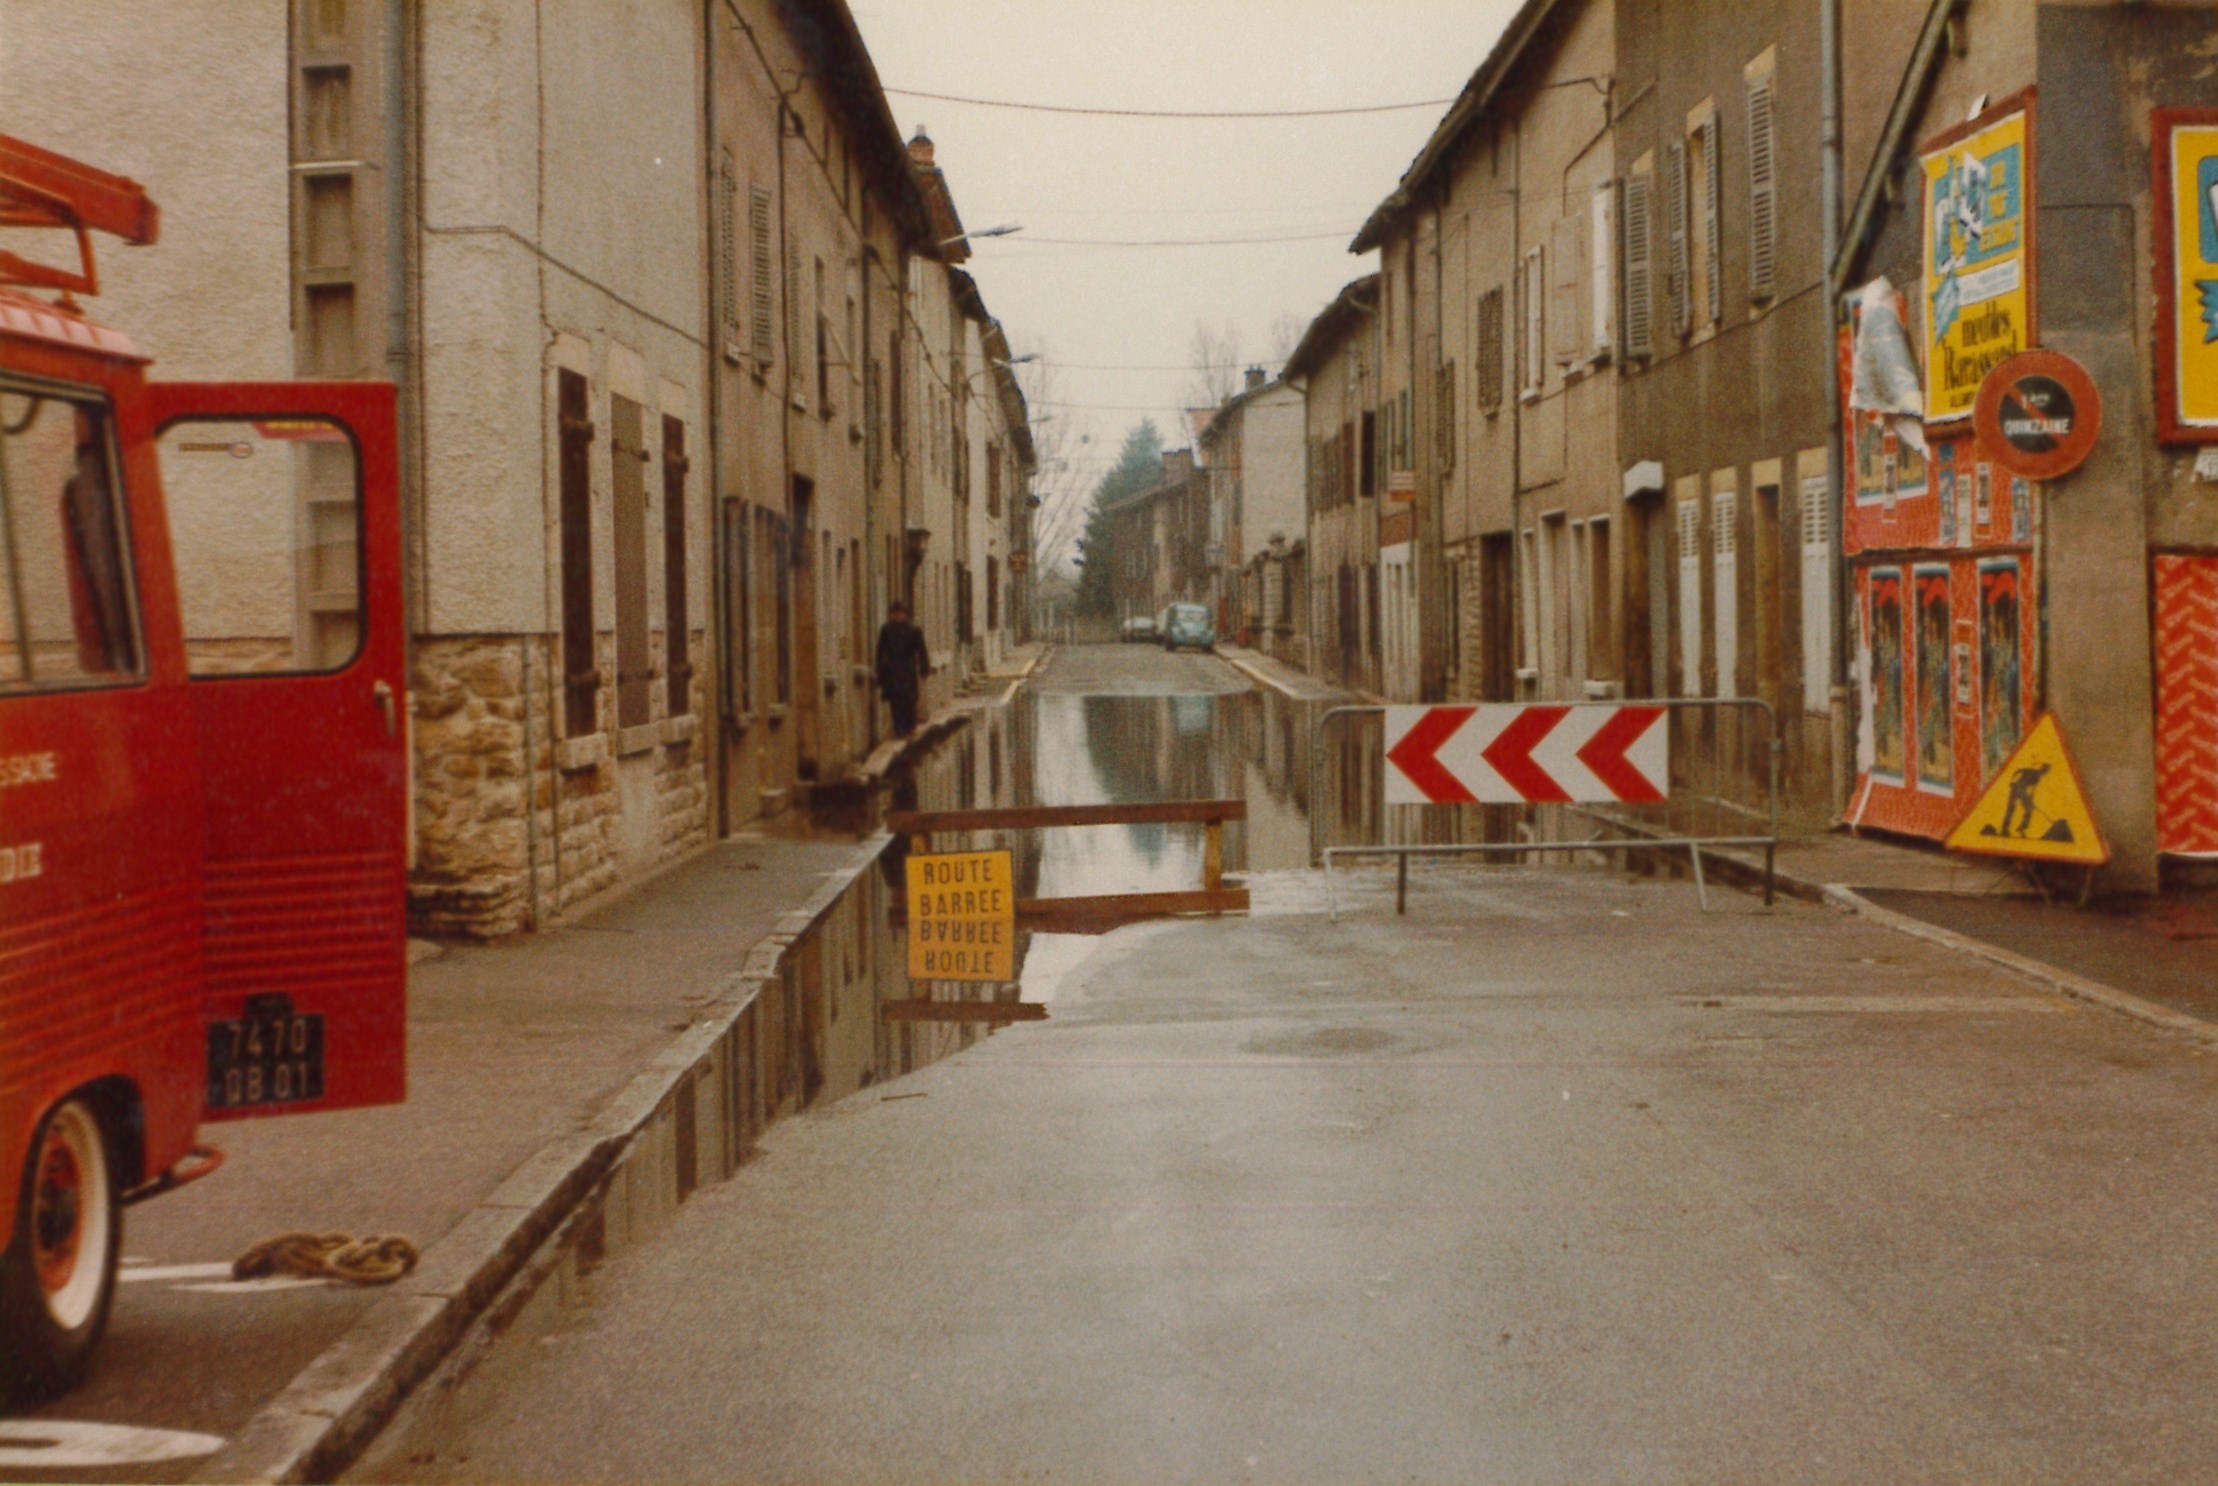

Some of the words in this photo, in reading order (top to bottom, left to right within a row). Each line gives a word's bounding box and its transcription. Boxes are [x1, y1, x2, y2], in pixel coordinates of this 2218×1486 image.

[2004, 417, 2070, 437] QUINZAINE
[923, 858, 993, 885] ROUTE
[919, 889, 1002, 916] BARREE
[225, 1018, 307, 1059] 7470
[273, 1062, 308, 1099] 01
